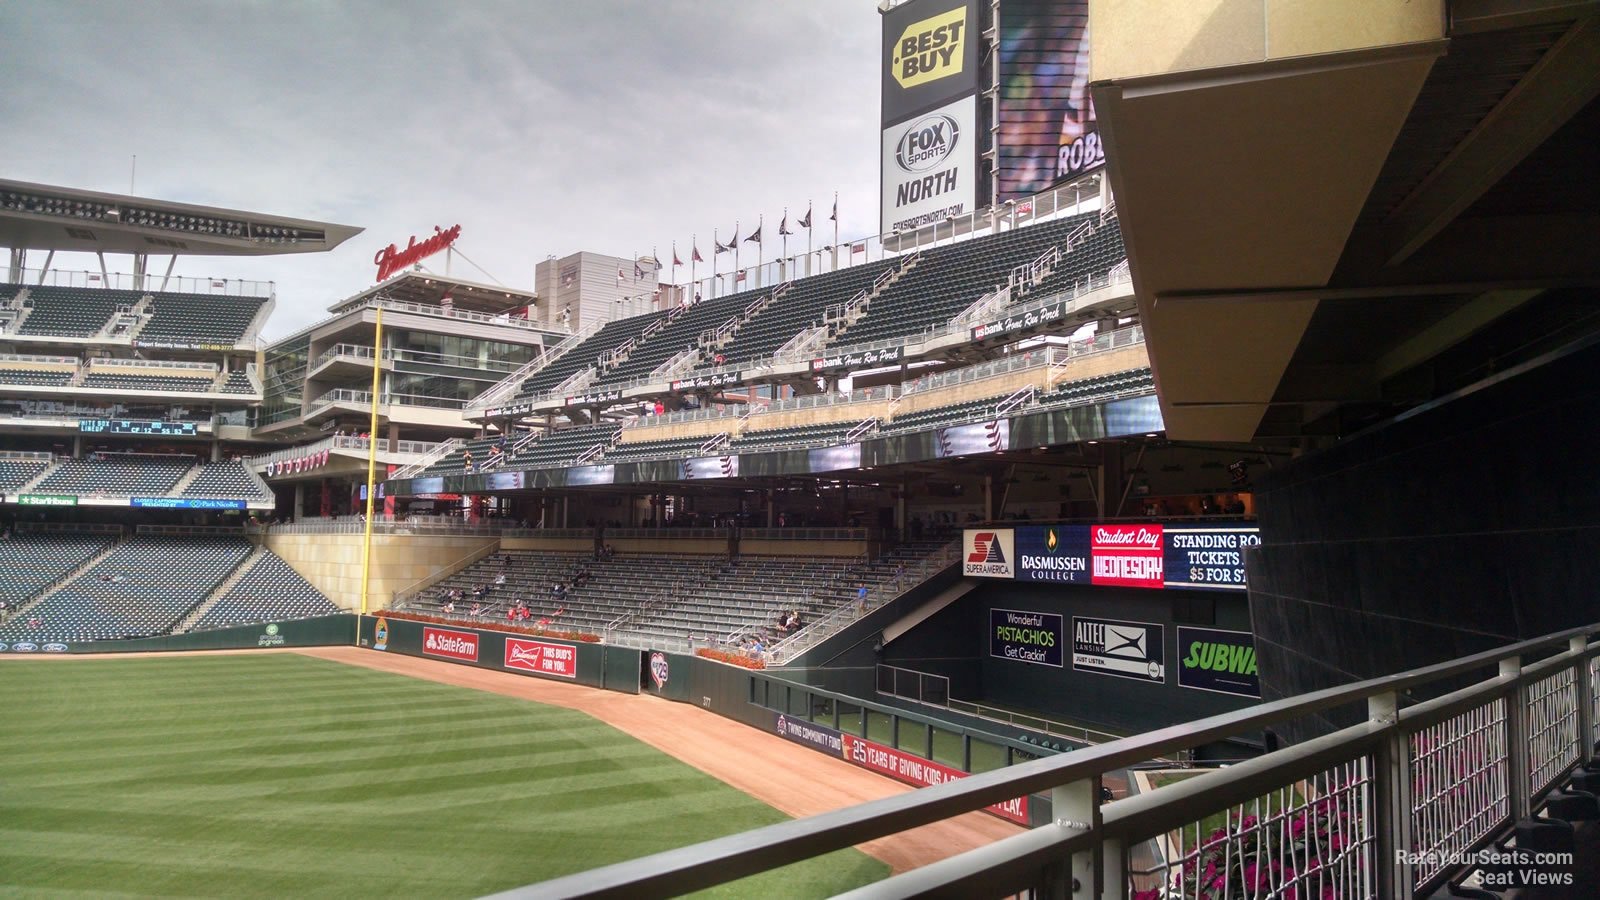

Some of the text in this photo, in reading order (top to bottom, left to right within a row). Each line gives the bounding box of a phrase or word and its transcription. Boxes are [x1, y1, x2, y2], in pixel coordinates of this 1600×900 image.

[901, 19, 964, 59] BEST
[902, 44, 958, 79] BUY
[909, 121, 945, 155] FOX
[908, 145, 946, 165] SPORTS
[896, 167, 958, 208] NORTH
[1004, 318, 1022, 332] Home
[1024, 313, 1038, 326] Run
[1040, 304, 1060, 323] Porch
[843, 355, 863, 366] Home
[863, 351, 878, 364] Run
[879, 346, 899, 362] Porch
[713, 373, 723, 384] Run
[1095, 528, 1159, 548] Student Day
[1173, 535, 1237, 548] STANDING
[1021, 555, 1086, 571] RASMUSSEN
[1188, 551, 1240, 565] TICKETS
[966, 564, 1009, 575] SUPERAMERICA
[1031, 570, 1075, 581] COLLEGE
[1093, 555, 1163, 580] WEDNESDAY
[1189, 566, 1204, 583] $5
[1206, 568, 1231, 582] FOR
[1007, 613, 1042, 627] Wonderful
[997, 626, 1055, 647] PISTACHIOS
[1076, 621, 1104, 645] ALTEC
[543, 646, 554, 658] THIS
[1004, 645, 1047, 662] Get Crackin'
[1075, 644, 1105, 653] LANSING
[543, 660, 566, 672] FOR YOU.
[703, 696, 711, 708] 377
[788, 721, 841, 751] TWINS COMMUNITY FUND
[853, 740, 866, 763] 25
[867, 748, 888, 768] YEARS
[889, 756, 897, 771] OF
[899, 758, 922, 780] GIVING
[923, 765, 941, 786] KIDS
